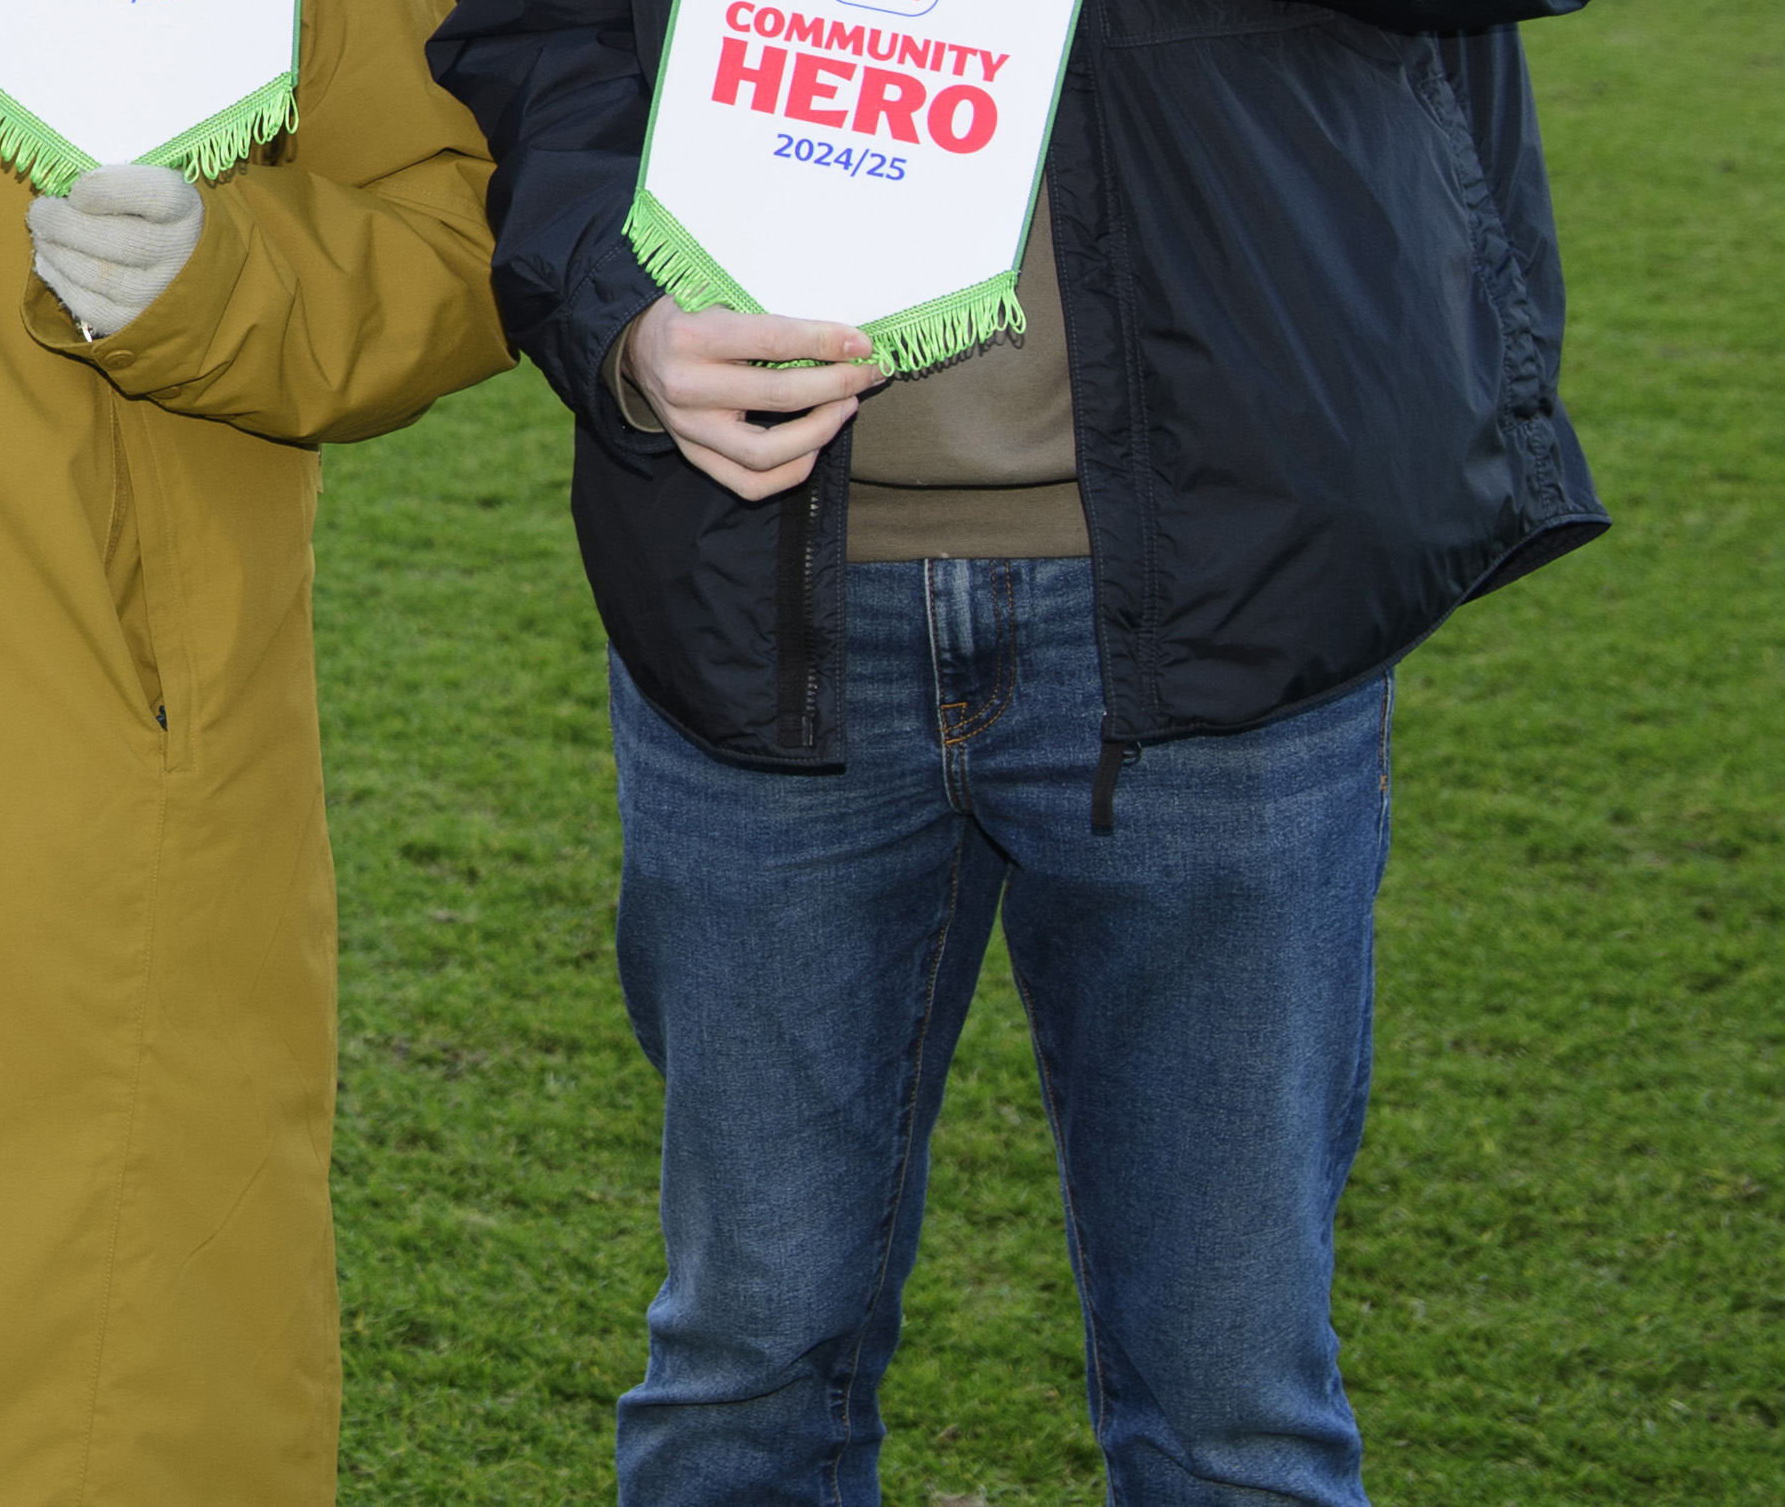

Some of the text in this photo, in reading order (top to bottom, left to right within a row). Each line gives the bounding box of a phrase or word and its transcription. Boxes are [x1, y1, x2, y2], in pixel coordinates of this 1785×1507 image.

[725, 0, 1011, 83] COMMUNITY
[711, 36, 999, 155] HERO
[773, 132, 908, 182] 2024/25
